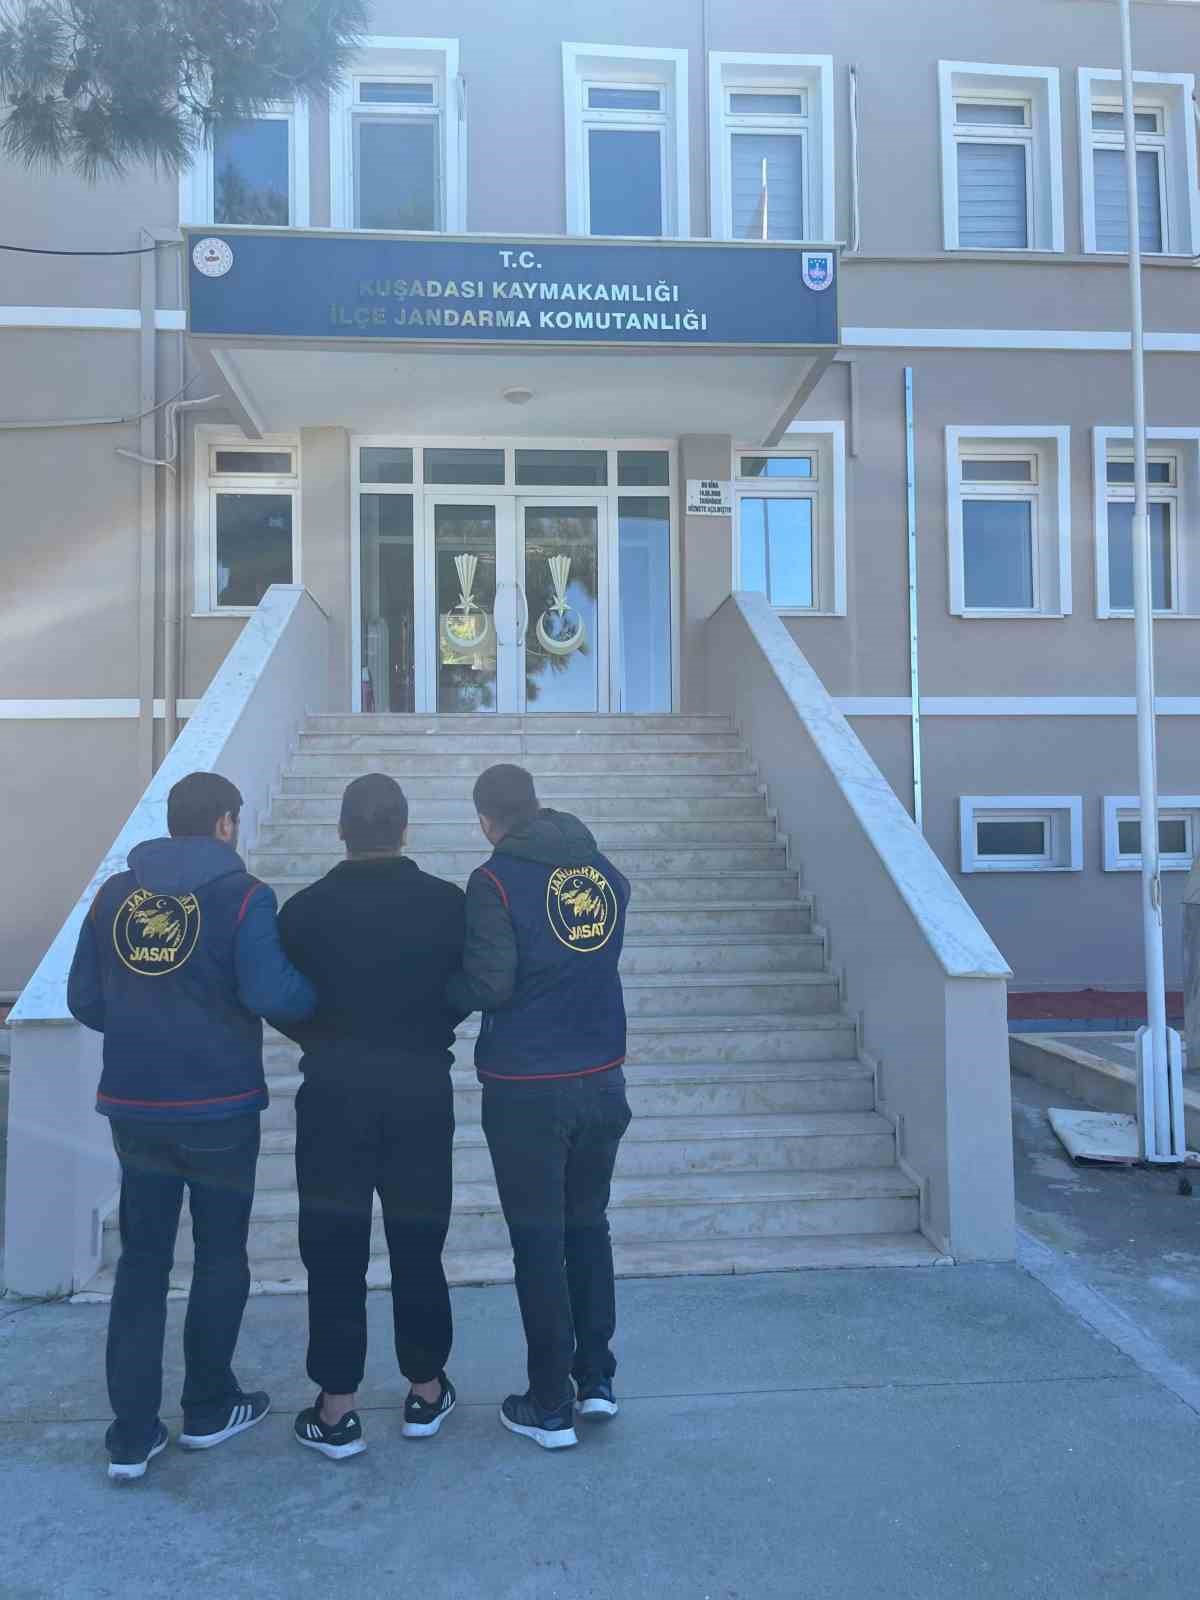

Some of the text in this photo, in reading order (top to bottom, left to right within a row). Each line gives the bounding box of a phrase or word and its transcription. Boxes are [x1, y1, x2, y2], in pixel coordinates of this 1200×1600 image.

[499, 250, 543, 269] T.C.
[359, 279, 679, 302] KUŞADASI KAYMAKAMLIĞI
[330, 303, 708, 331] İLÇE JANDARMA KOMUTANLIĞI
[568, 921, 605, 941] JASAT
[129, 946, 178, 962] JASAT
